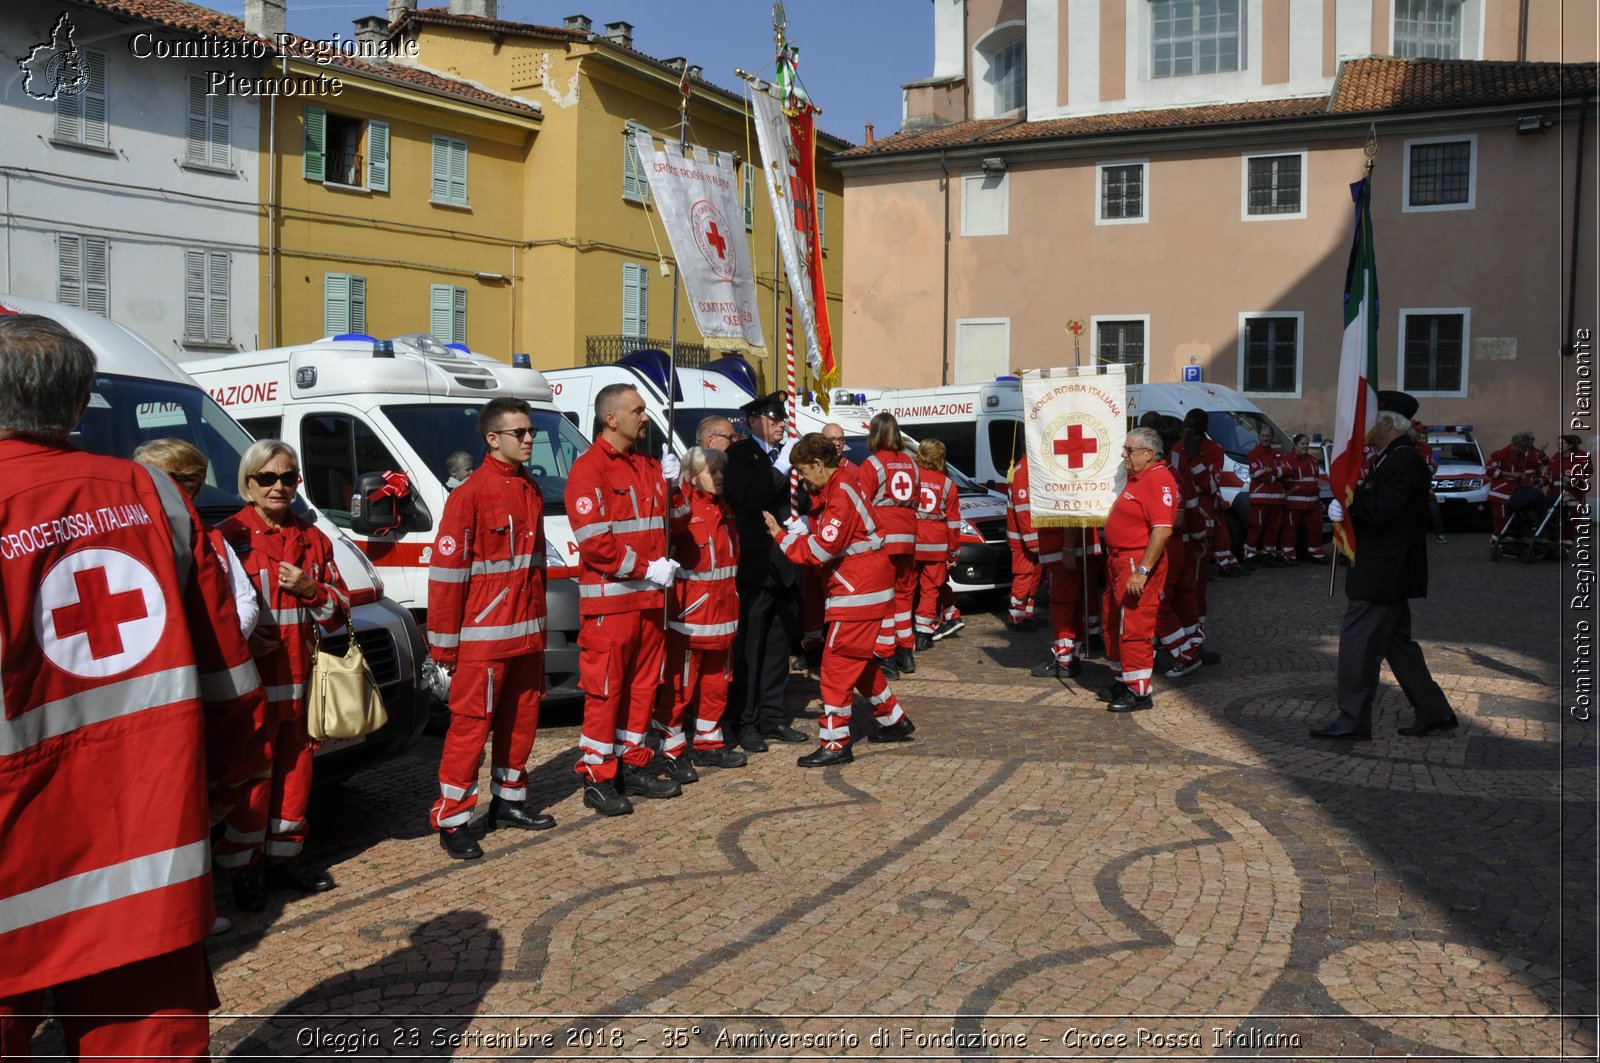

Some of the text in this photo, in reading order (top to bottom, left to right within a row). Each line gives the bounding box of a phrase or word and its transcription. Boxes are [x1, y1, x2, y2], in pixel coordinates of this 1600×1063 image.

[653, 162, 680, 177] CROCE
[680, 168, 705, 183] ROSSA
[1188, 368, 1197, 380] P
[893, 402, 973, 418] RIANIMAZIONE
[1030, 384, 1121, 421] CROCE ROSSA ITALIANA
[1045, 482, 1097, 493] COMITATO
[1054, 499, 1103, 510] ARONA
[0, 504, 152, 560] CROCE ROSSA ITALIANA
